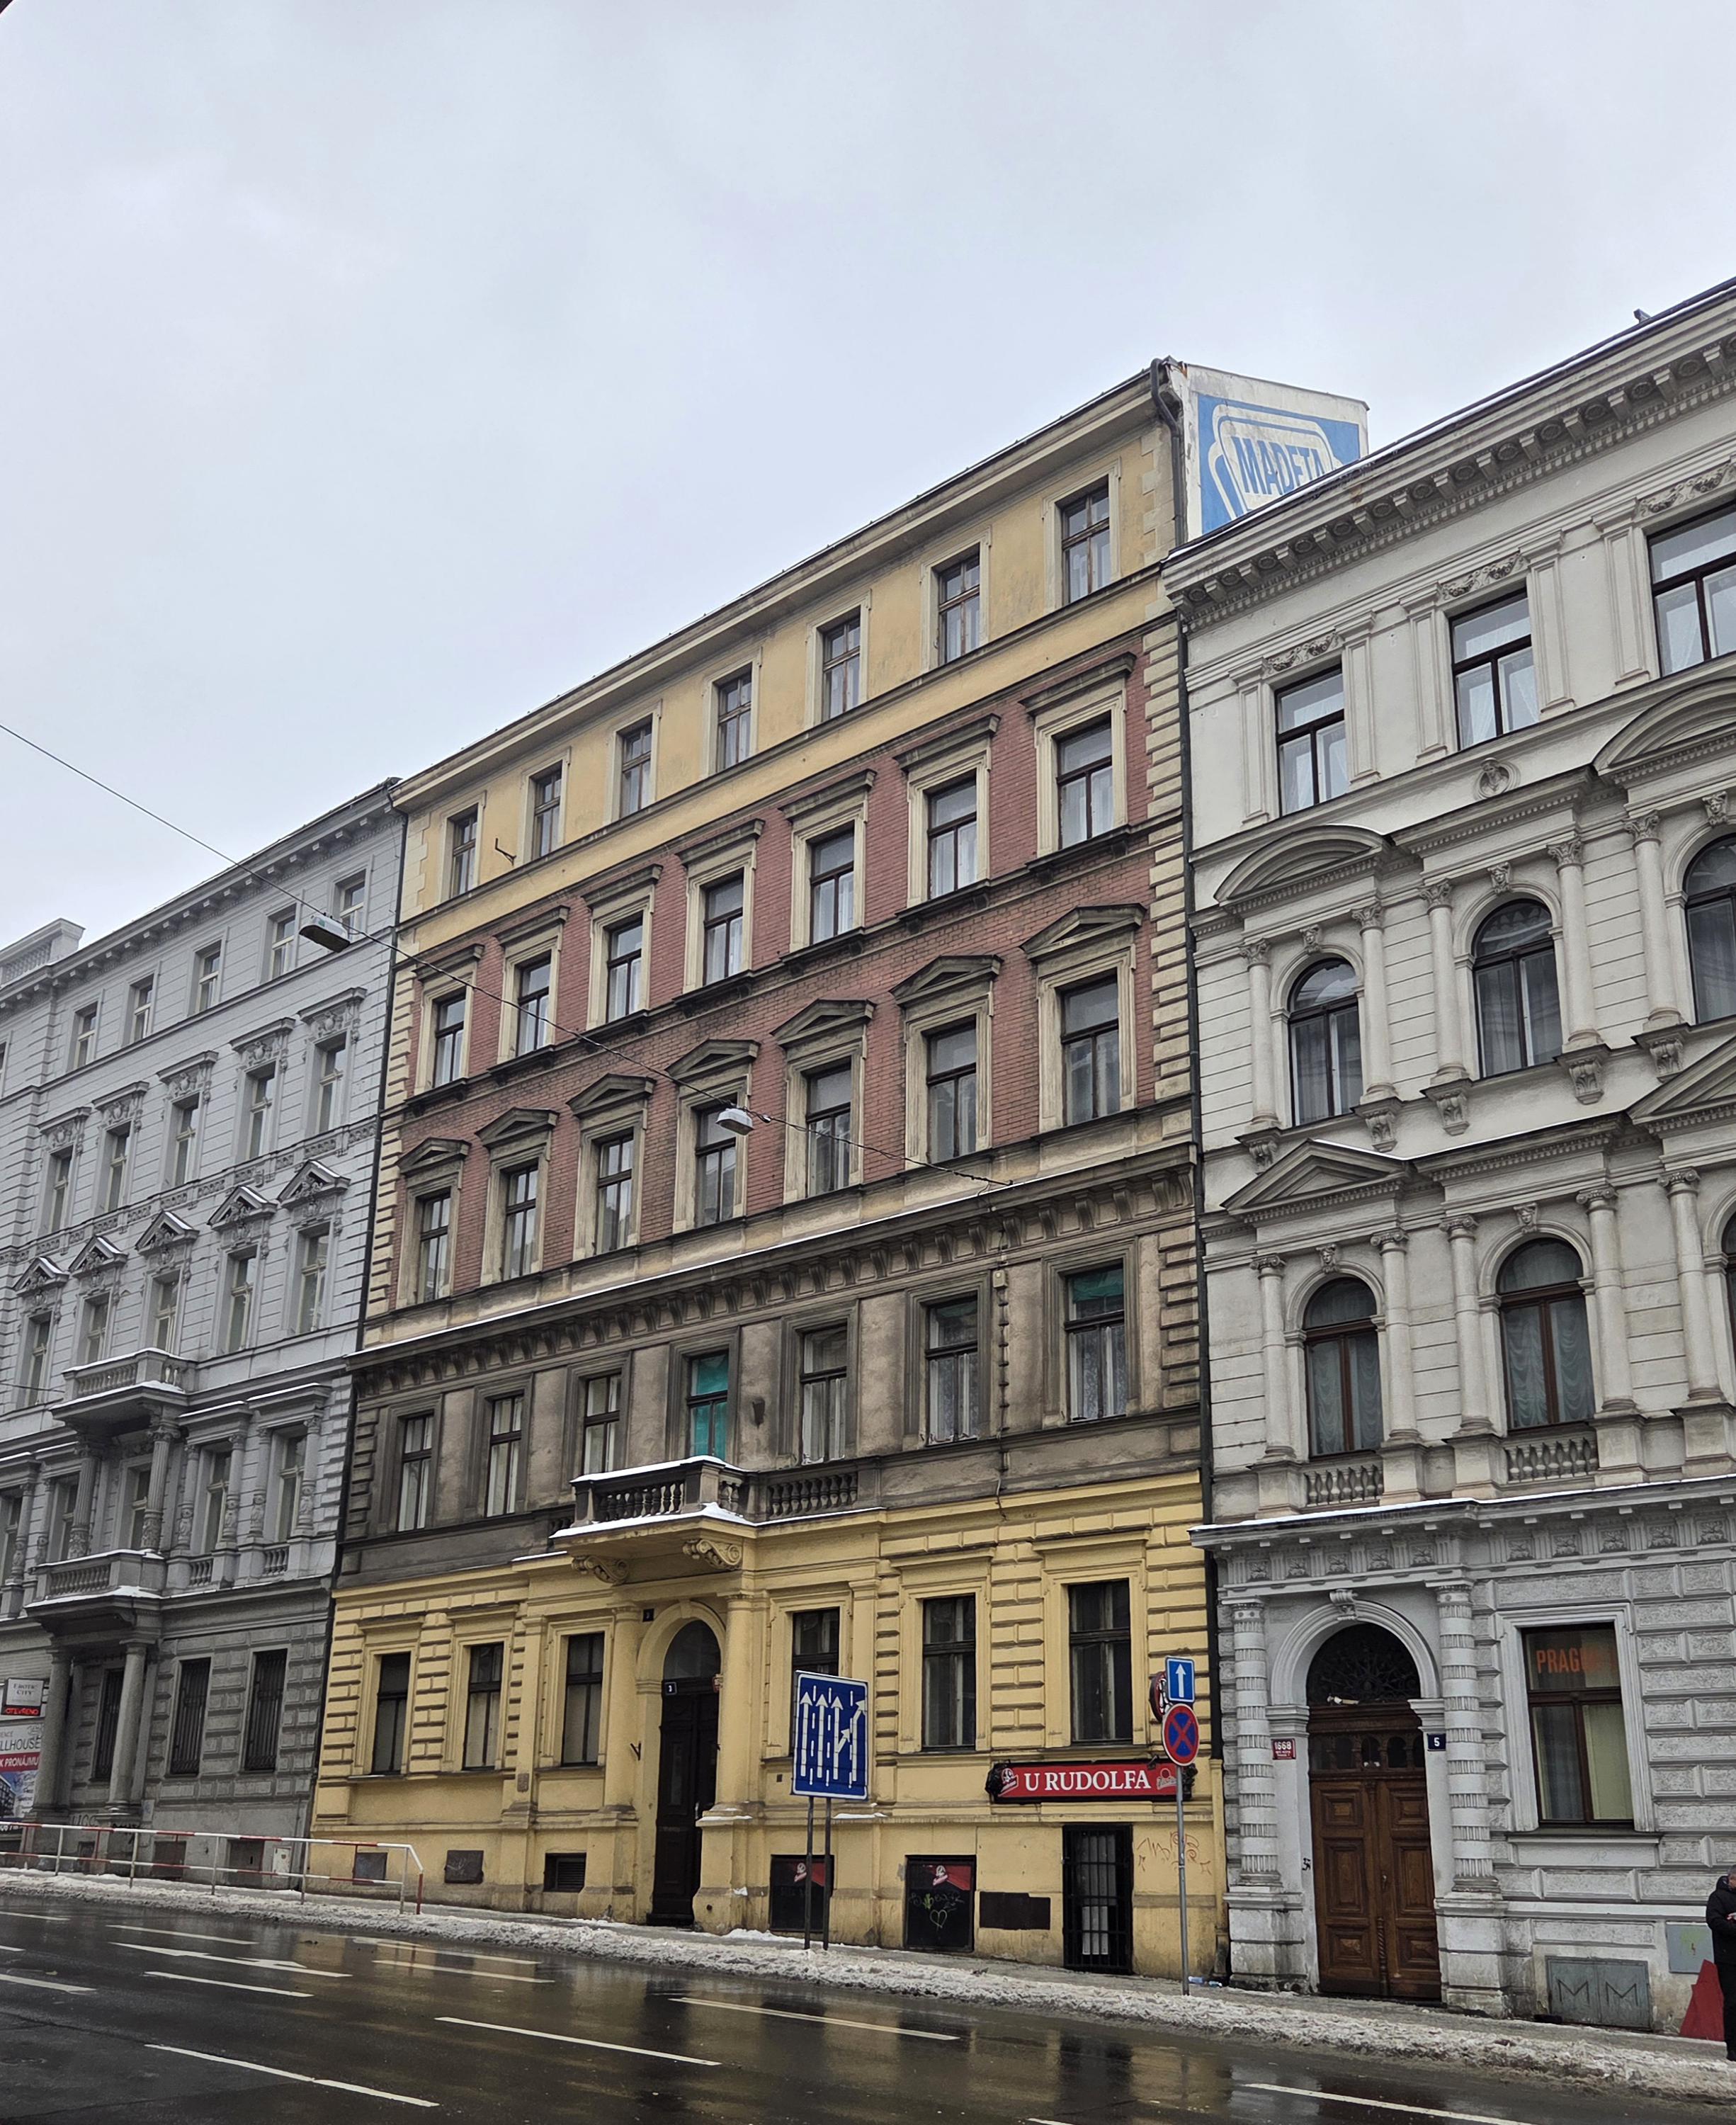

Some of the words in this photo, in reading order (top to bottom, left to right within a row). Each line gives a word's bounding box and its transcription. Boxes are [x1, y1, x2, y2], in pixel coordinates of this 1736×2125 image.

[1275, 1741, 1292, 1750] 1668
[1434, 1737, 1440, 1747] 5
[1023, 1773, 1040, 1791] U
[1045, 1770, 1152, 1791] RUDOLFA
